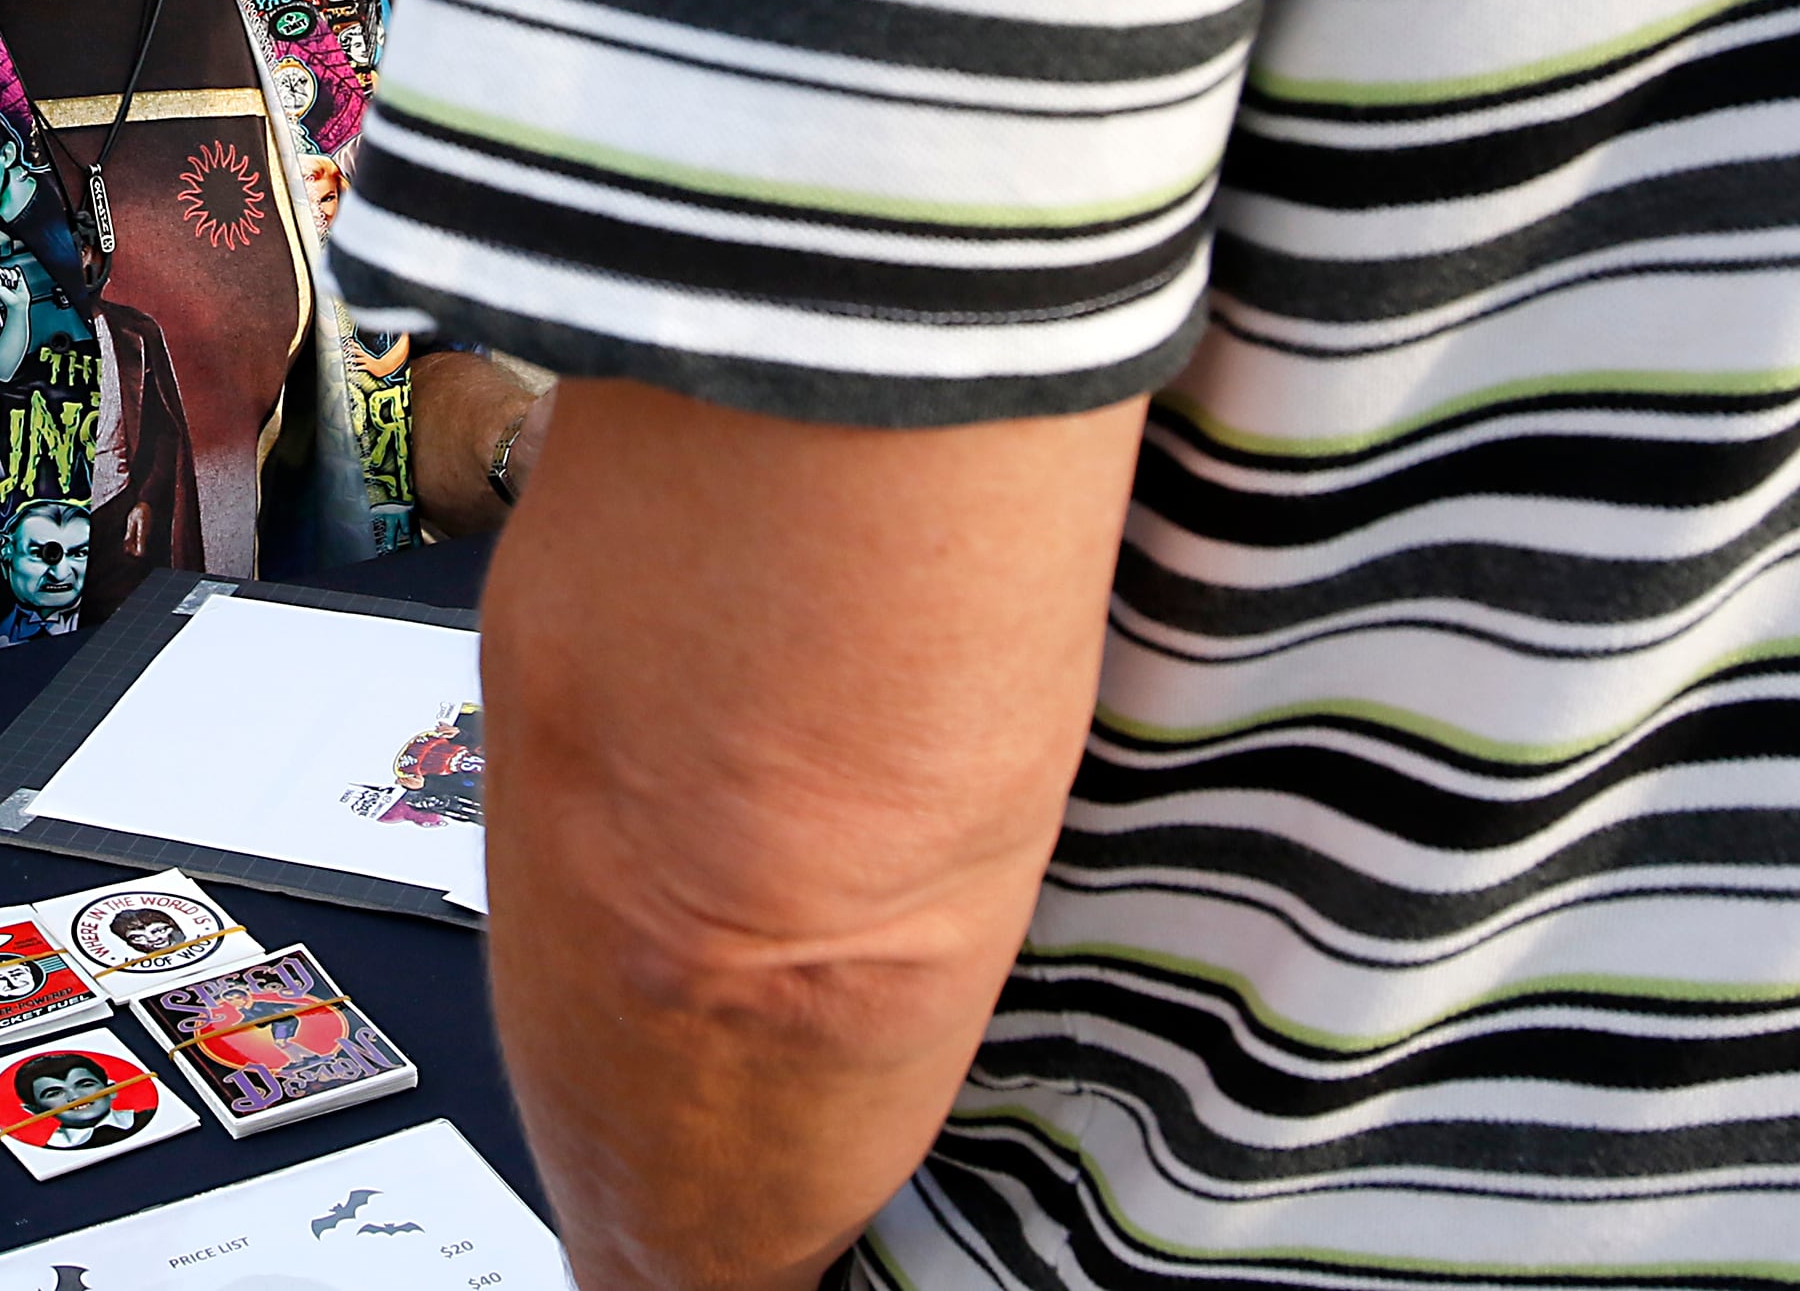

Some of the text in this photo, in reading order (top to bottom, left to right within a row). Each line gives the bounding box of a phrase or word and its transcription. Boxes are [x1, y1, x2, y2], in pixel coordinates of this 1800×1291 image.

[81, 895, 212, 958] WHERE IN THE WORLD IS
[177, 934, 212, 960] WOO
[48, 993, 92, 1013] FUEL
[168, 1236, 251, 1270] PRICE LIST
[439, 1239, 475, 1260] $20
[467, 1270, 503, 1291] $40
